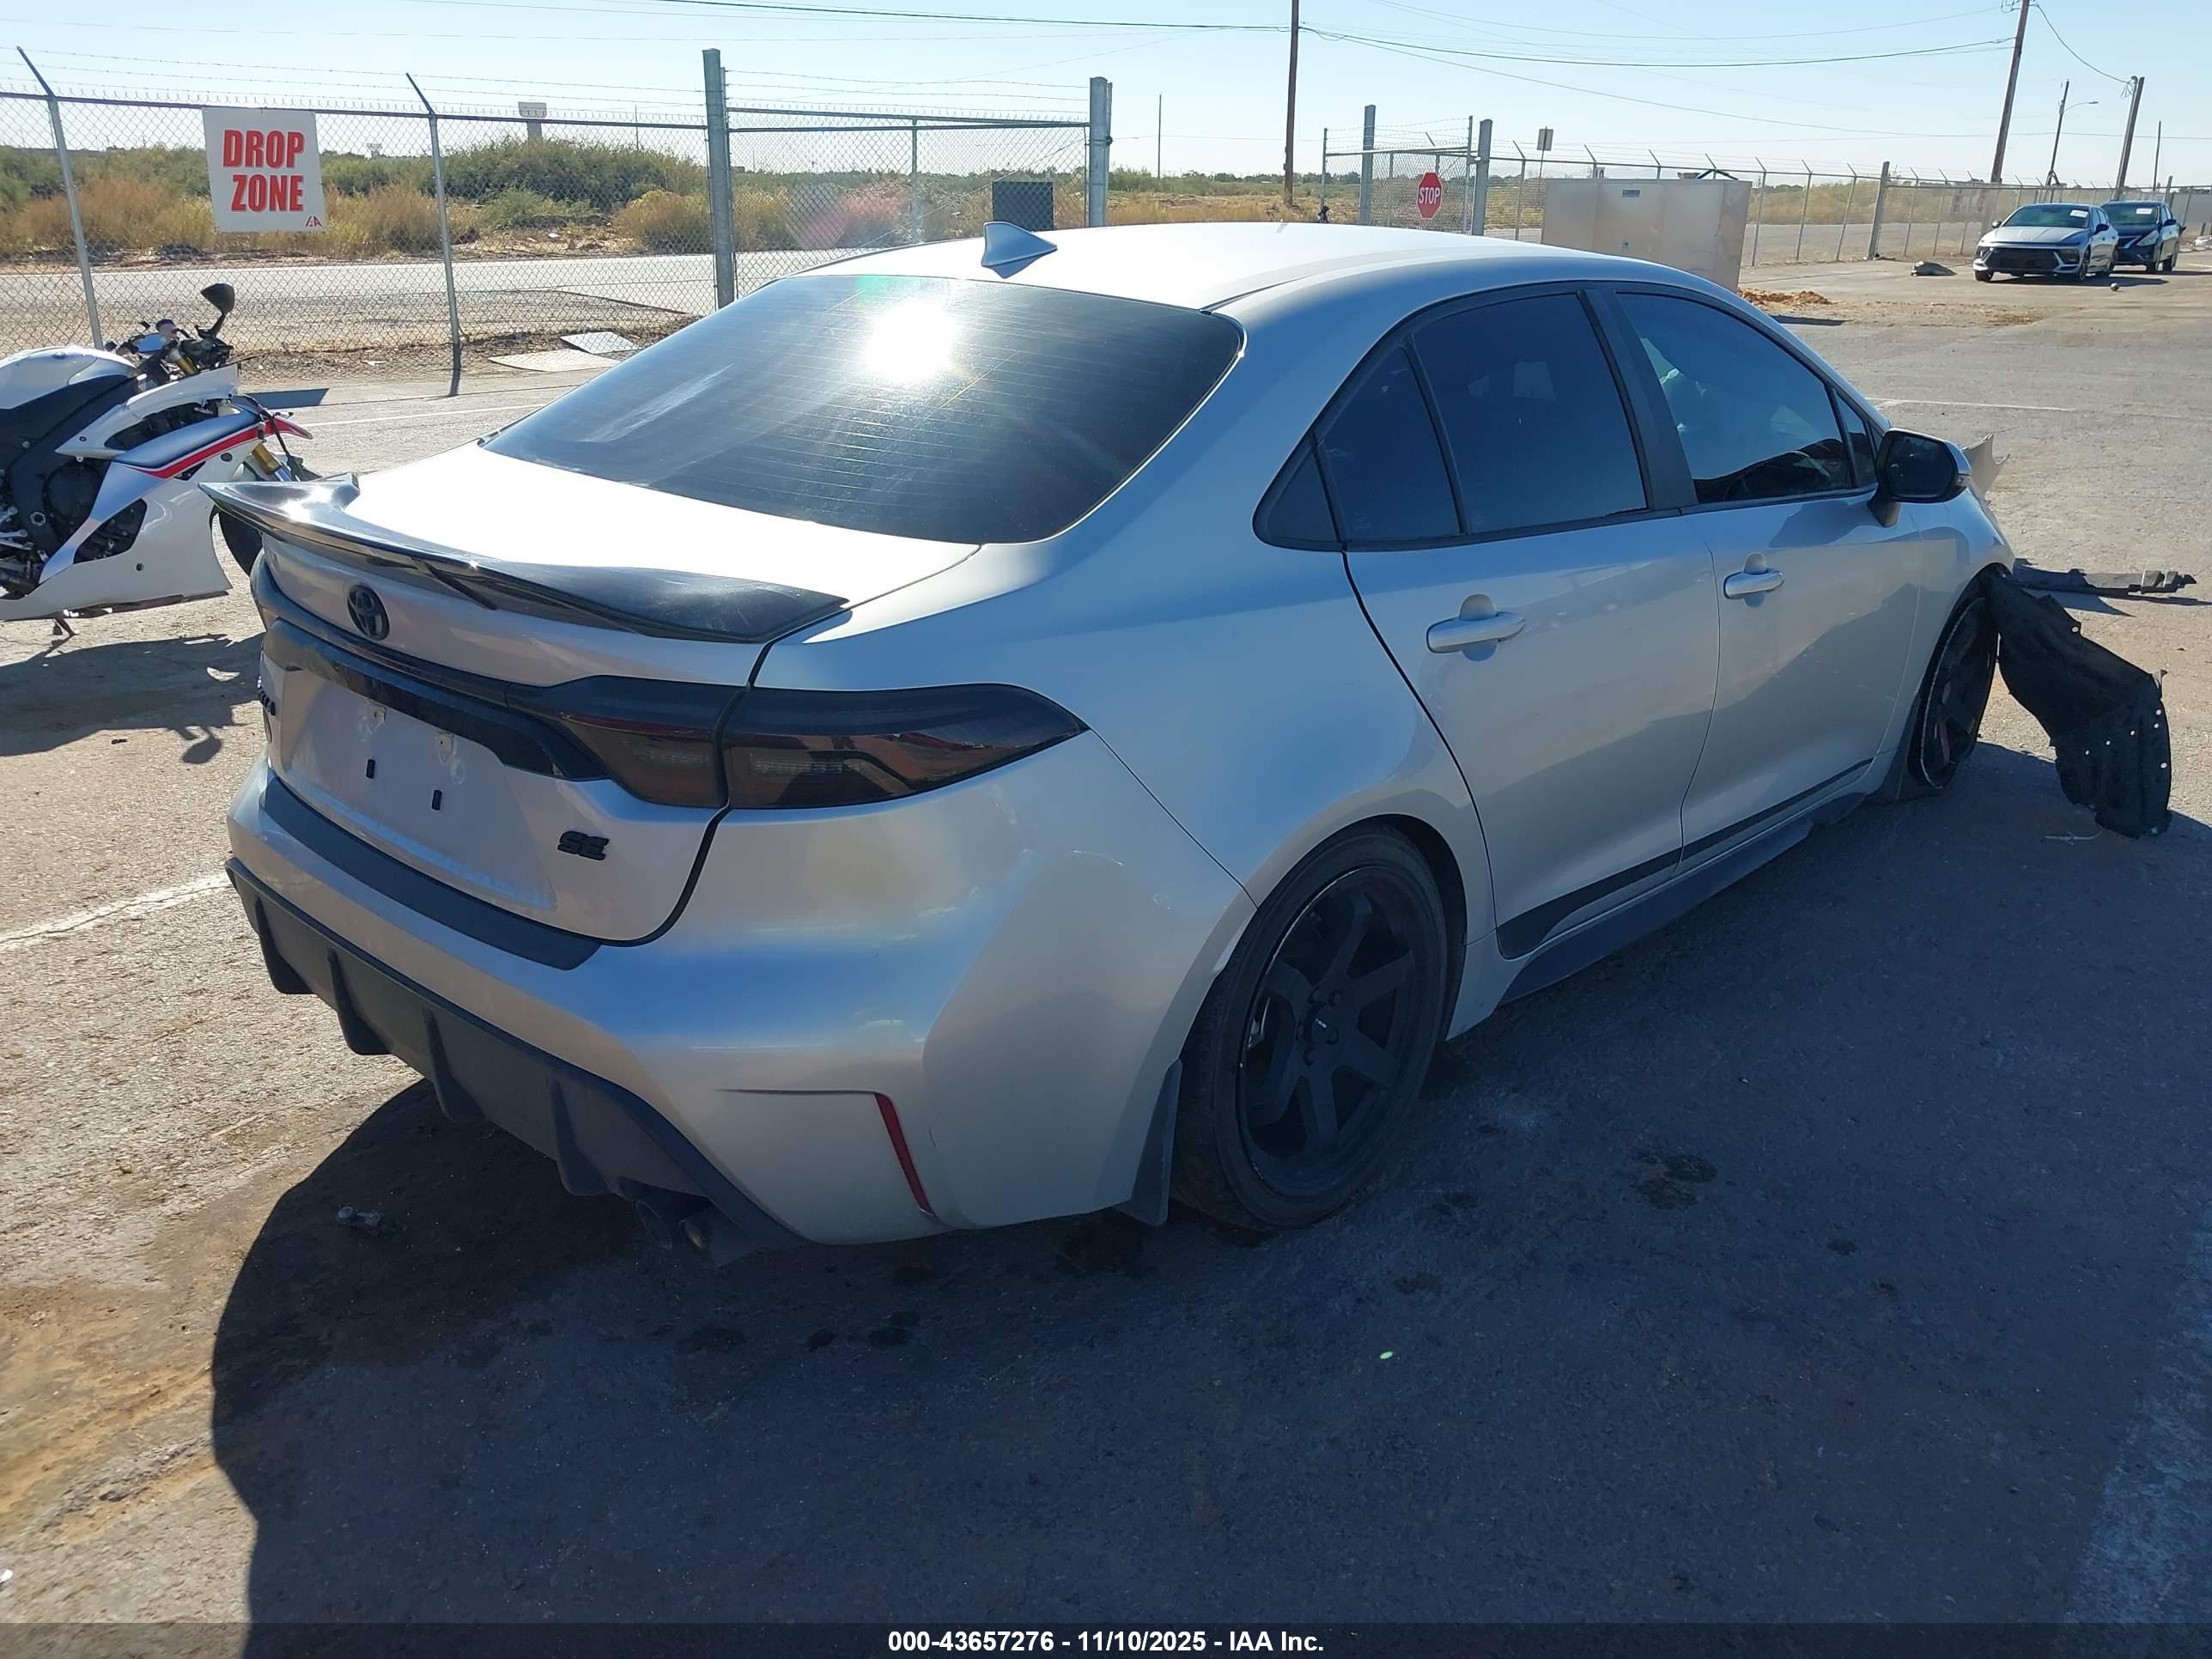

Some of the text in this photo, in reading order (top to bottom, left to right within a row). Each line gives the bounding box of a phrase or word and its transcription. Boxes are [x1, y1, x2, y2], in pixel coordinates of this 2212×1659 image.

[222, 130, 305, 169] DROP
[230, 173, 304, 212] ZONE
[1419, 186, 1441, 204] STOP
[556, 830, 610, 861] SE
